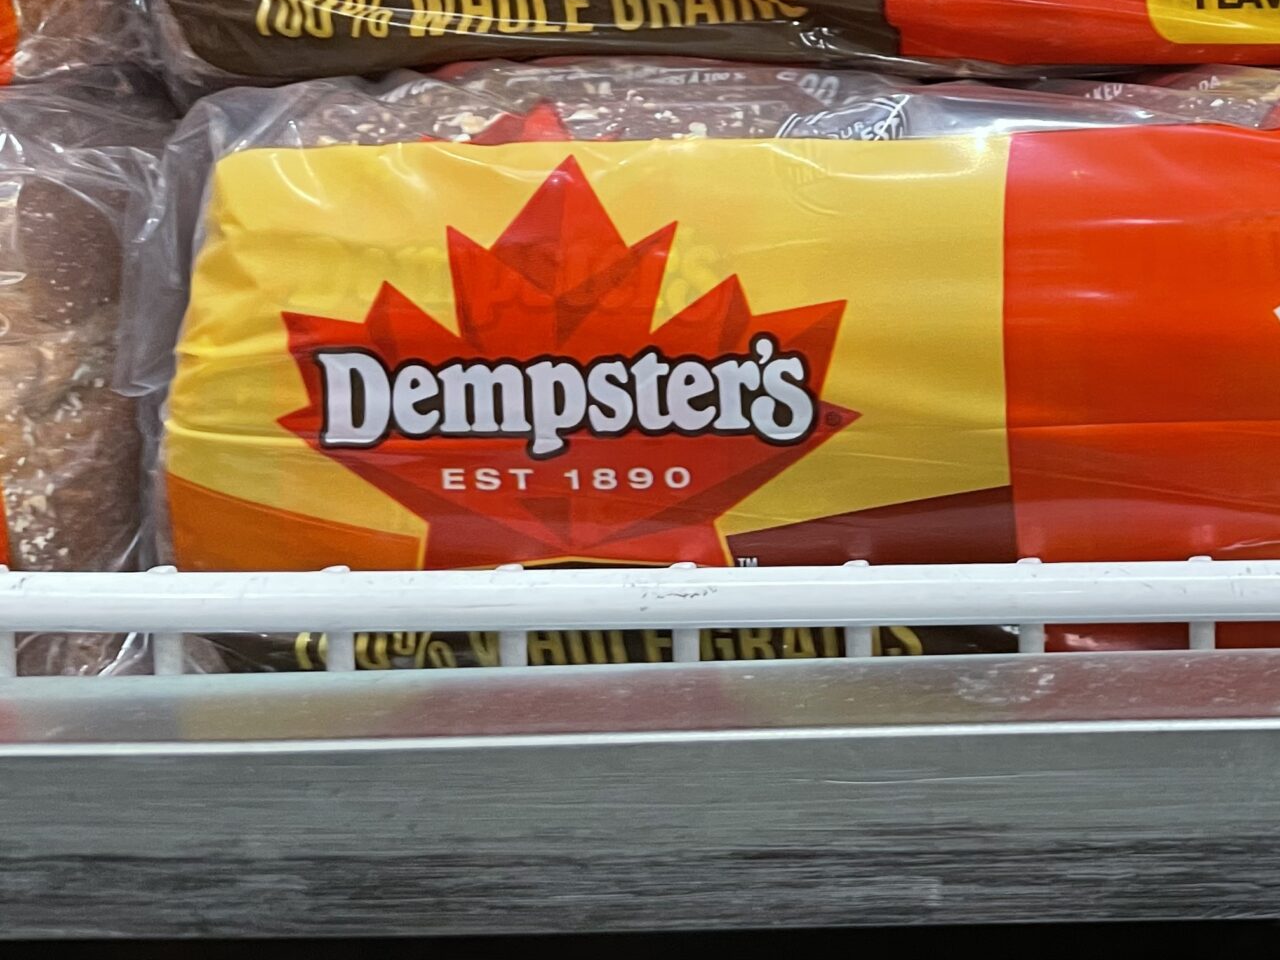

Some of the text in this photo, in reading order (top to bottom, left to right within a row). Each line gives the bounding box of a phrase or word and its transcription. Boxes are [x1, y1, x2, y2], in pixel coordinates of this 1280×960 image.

[318, 336, 815, 454] Dempster's
[443, 466, 693, 491] EST 1890
